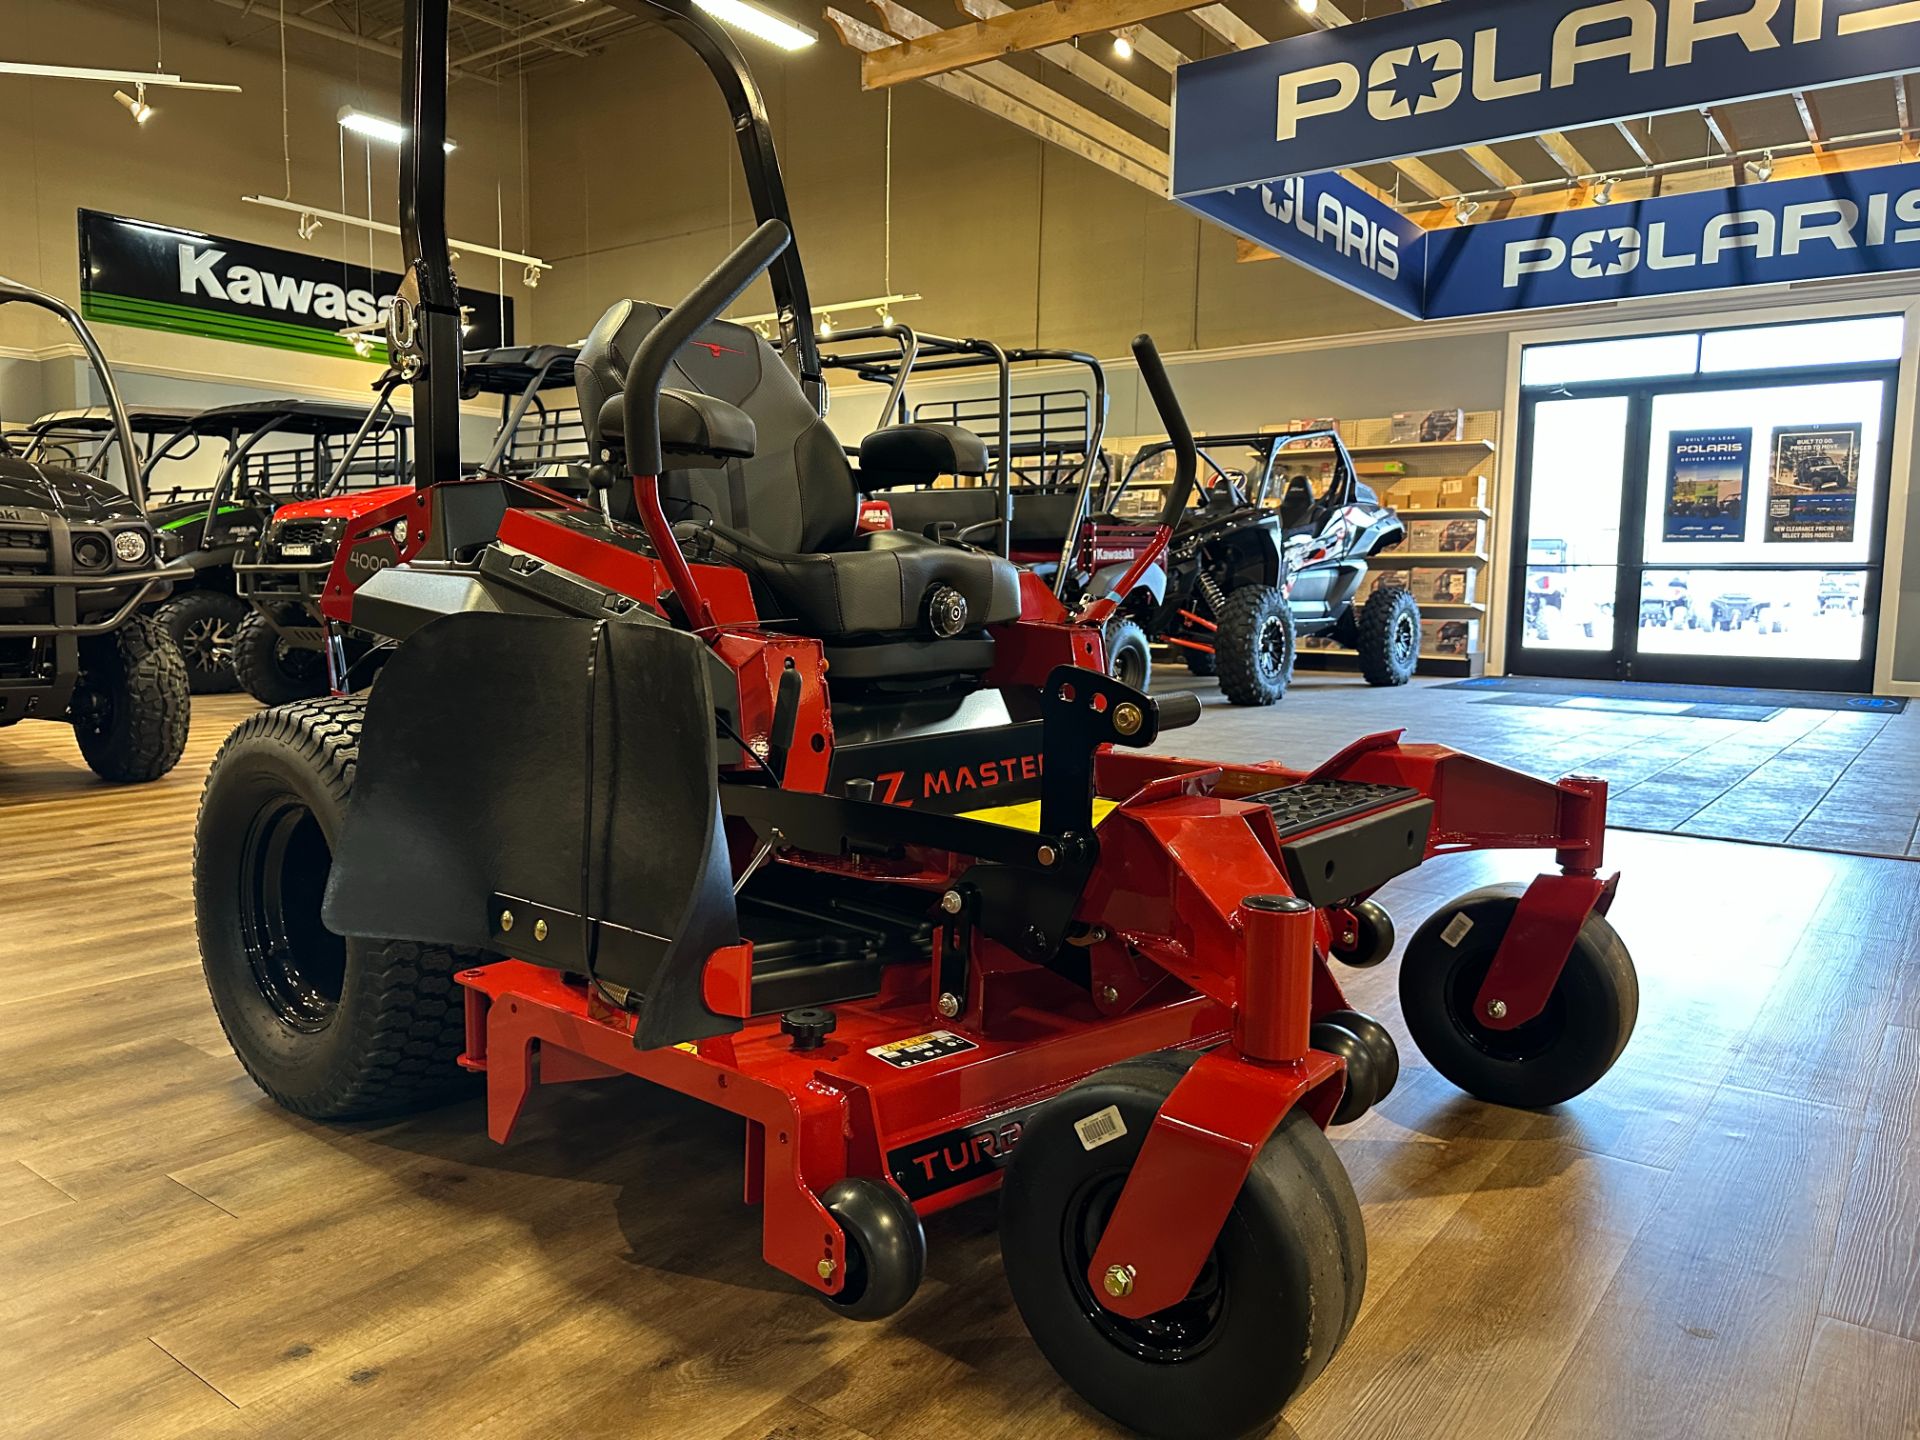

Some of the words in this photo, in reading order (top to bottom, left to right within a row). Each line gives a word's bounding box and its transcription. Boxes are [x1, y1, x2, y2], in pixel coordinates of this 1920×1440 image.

[1258, 176, 1399, 280] OLARIS
[1676, 443, 1742, 454] POLARIS
[1097, 548, 1134, 560] Kawasaki
[924, 753, 1043, 798] MASTE
[912, 1122, 1024, 1181] TURB
